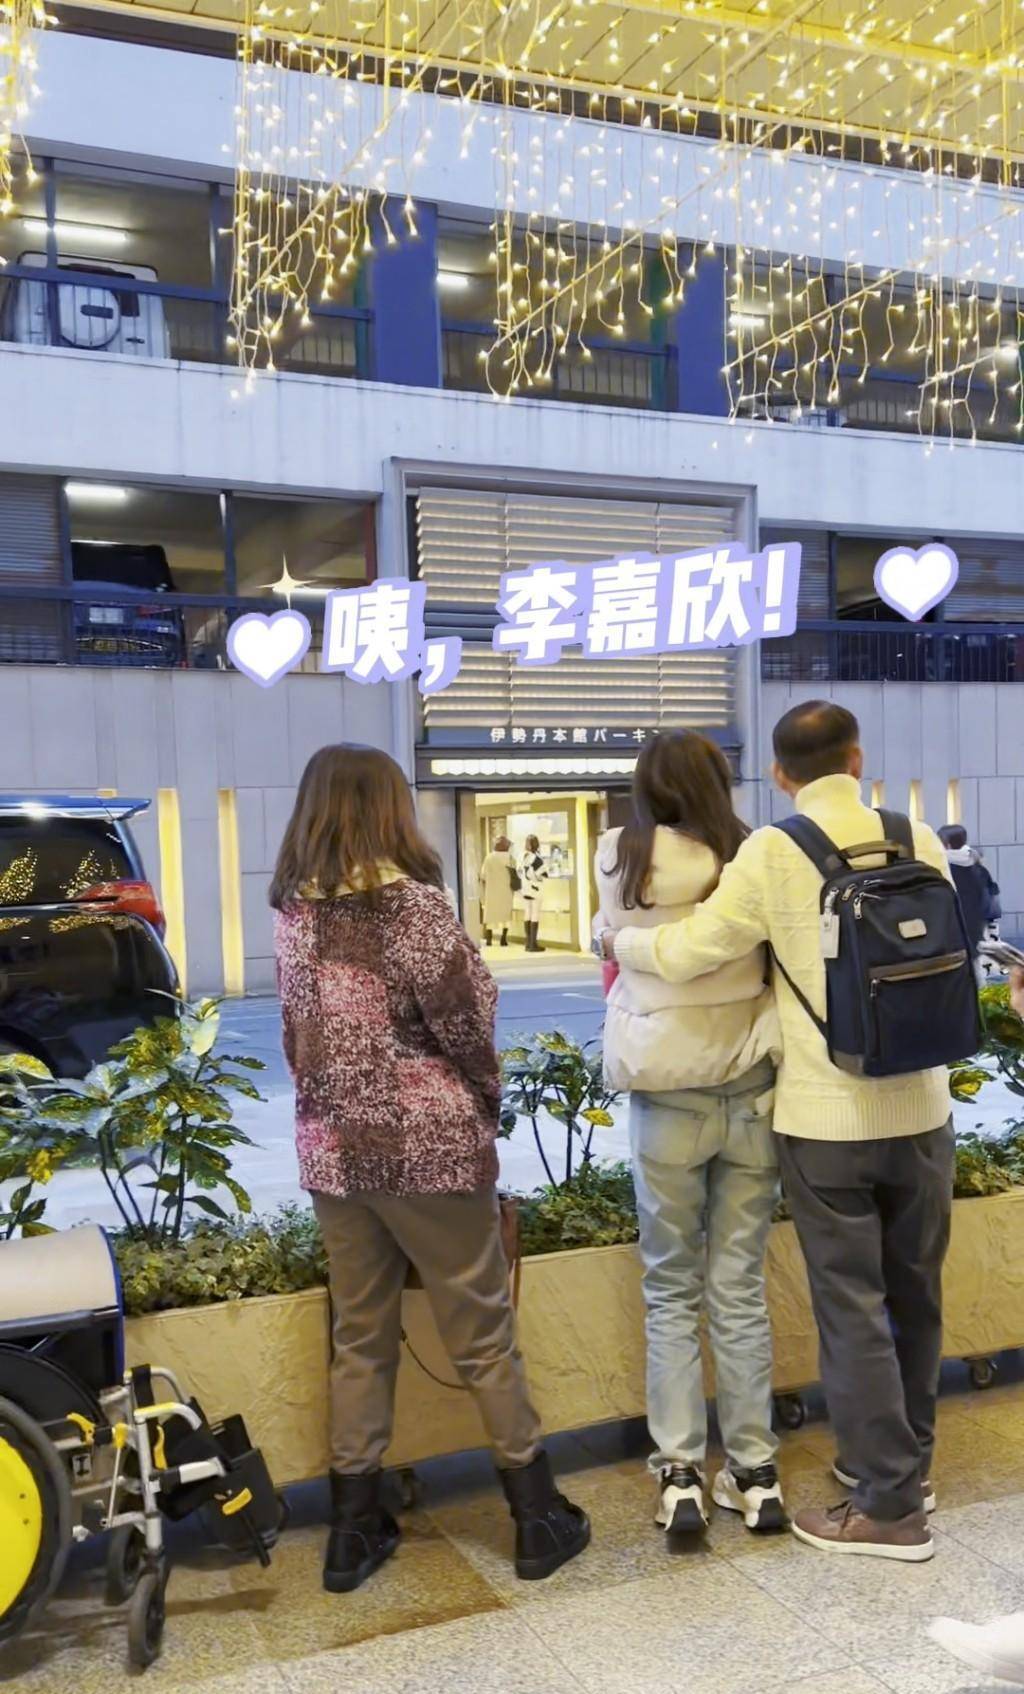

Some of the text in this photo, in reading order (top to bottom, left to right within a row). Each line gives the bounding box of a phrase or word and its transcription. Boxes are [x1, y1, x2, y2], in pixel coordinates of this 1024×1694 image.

[489, 726, 660, 744] 伊勢丹本館パーキ
